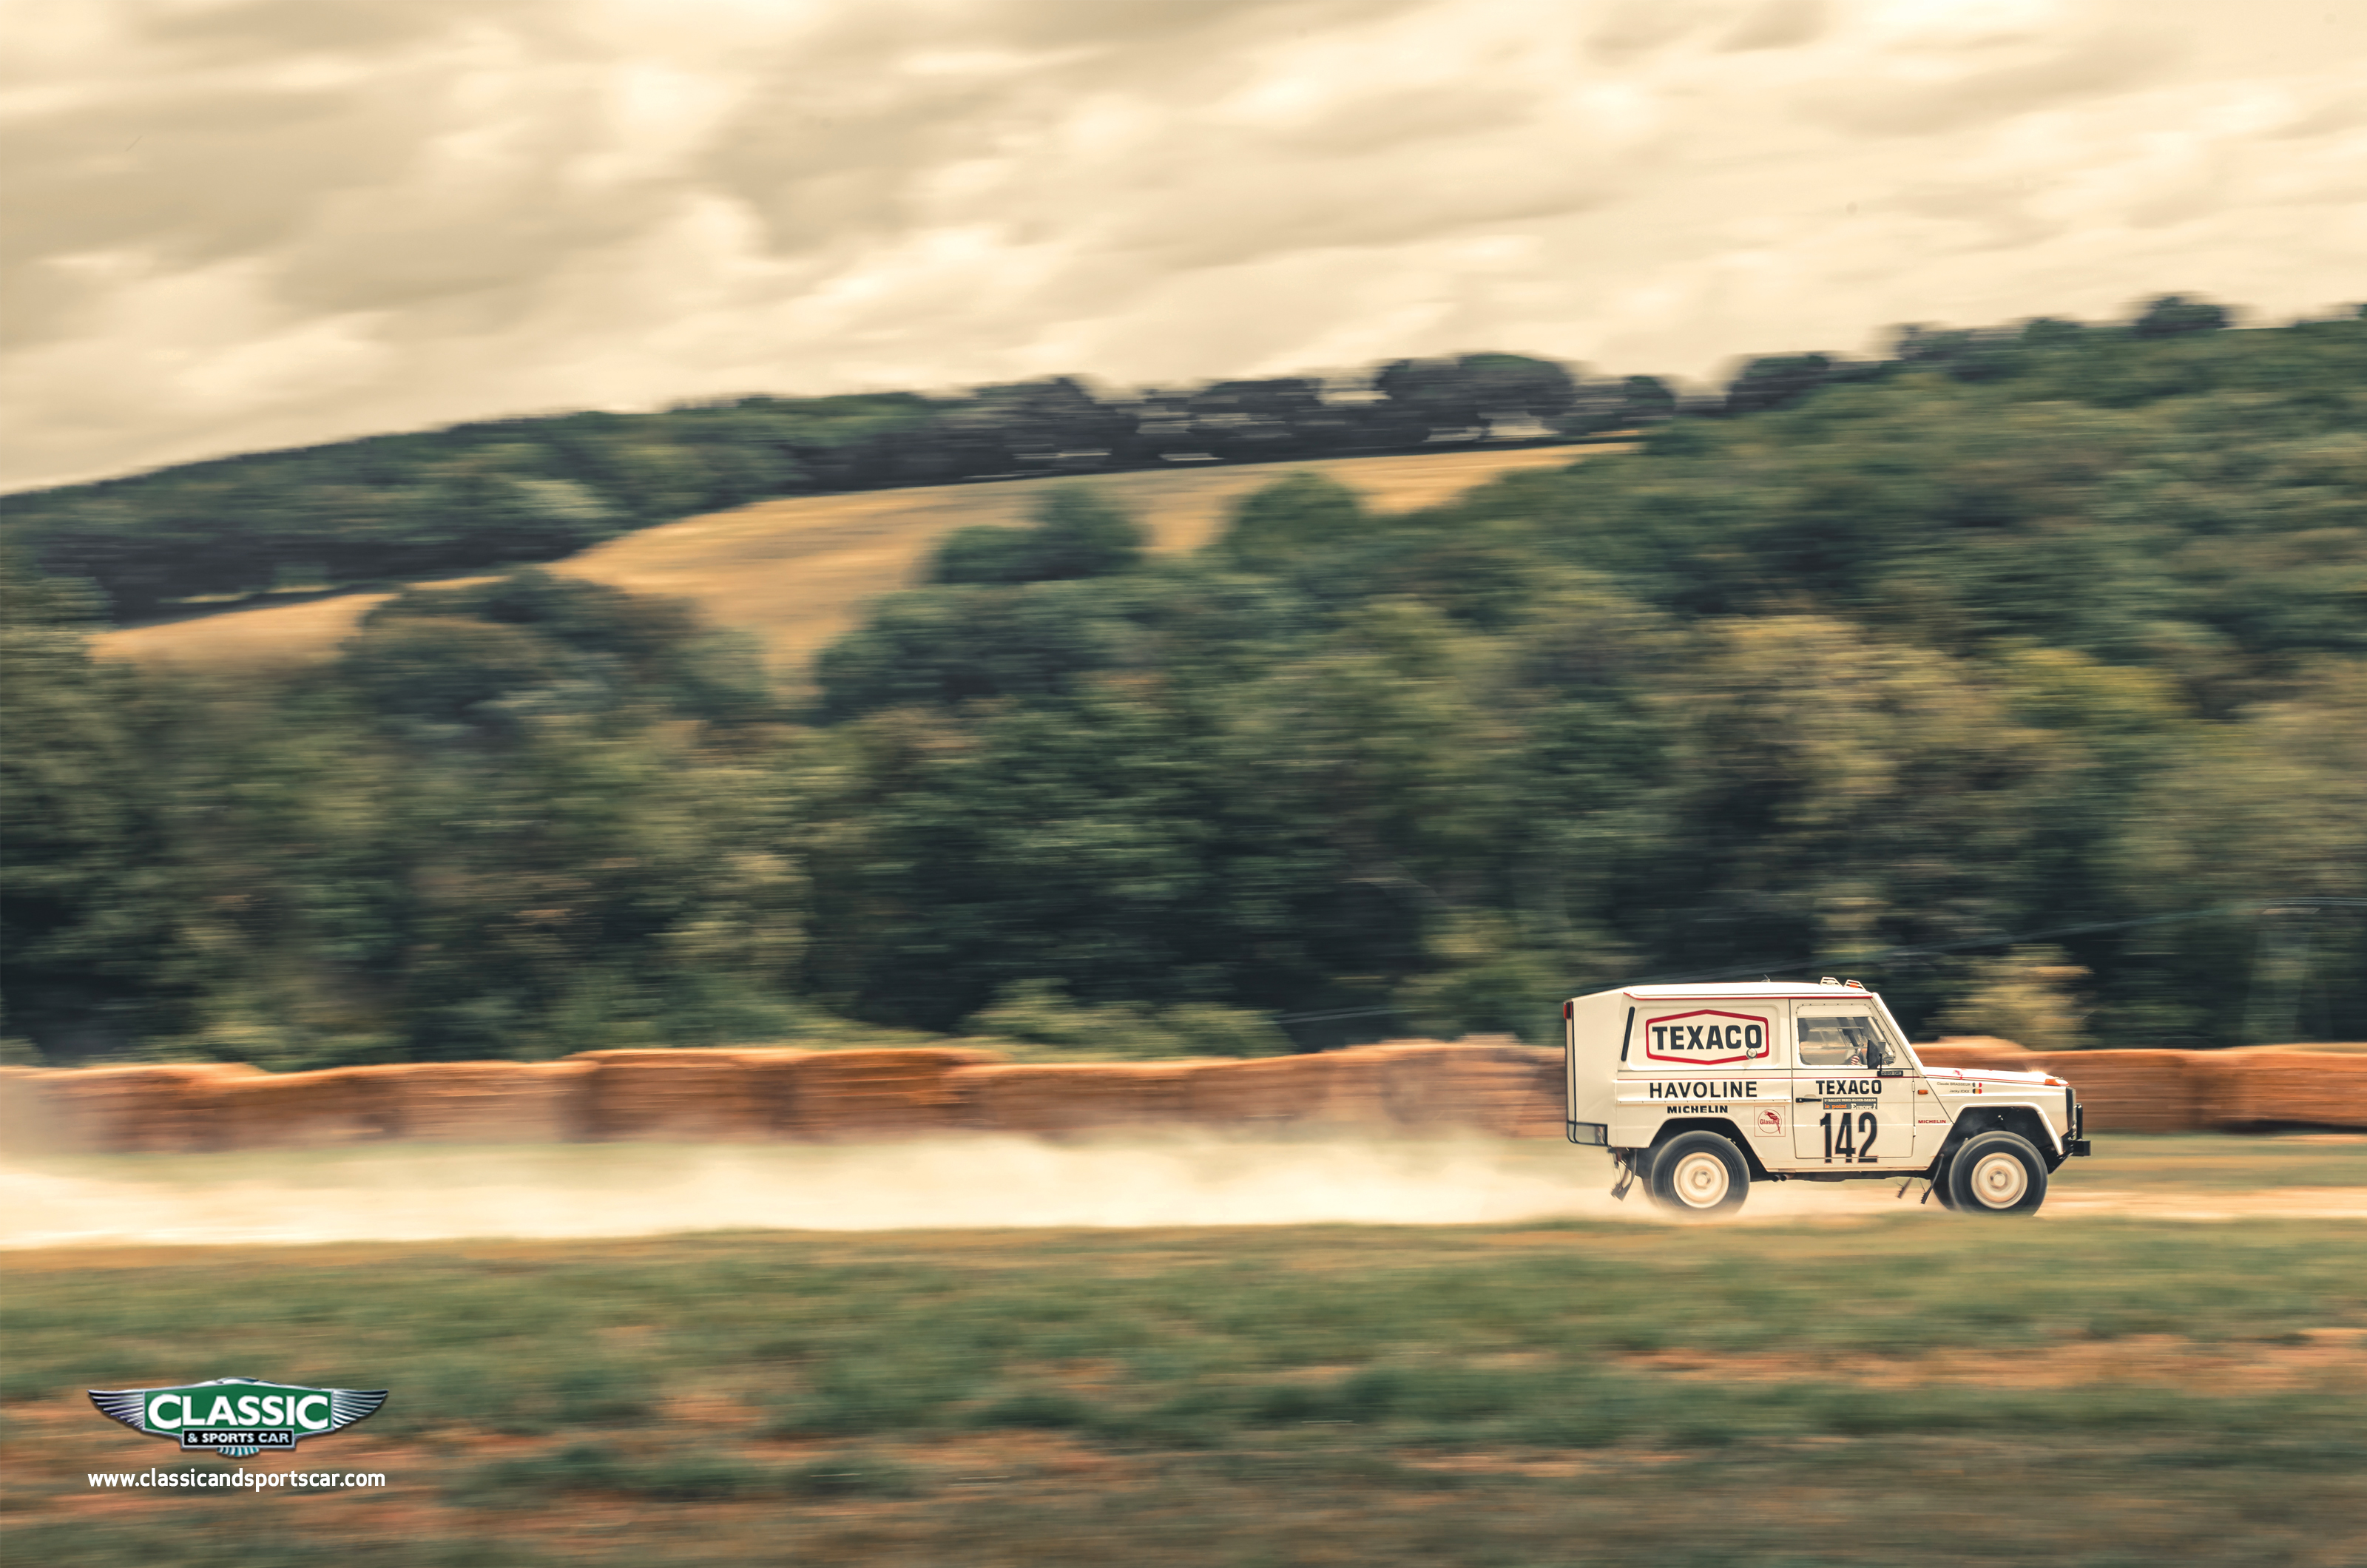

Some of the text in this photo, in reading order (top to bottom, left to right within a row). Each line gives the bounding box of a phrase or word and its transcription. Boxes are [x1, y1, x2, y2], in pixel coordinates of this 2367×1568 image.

[1652, 1024, 1762, 1050] TEXACO
[1650, 1081, 1757, 1098] HAVOLINE
[1815, 1079, 1882, 1095] TEXACO
[1667, 1105, 1728, 1114] MICHELIN
[1820, 1112, 1879, 1164] 142
